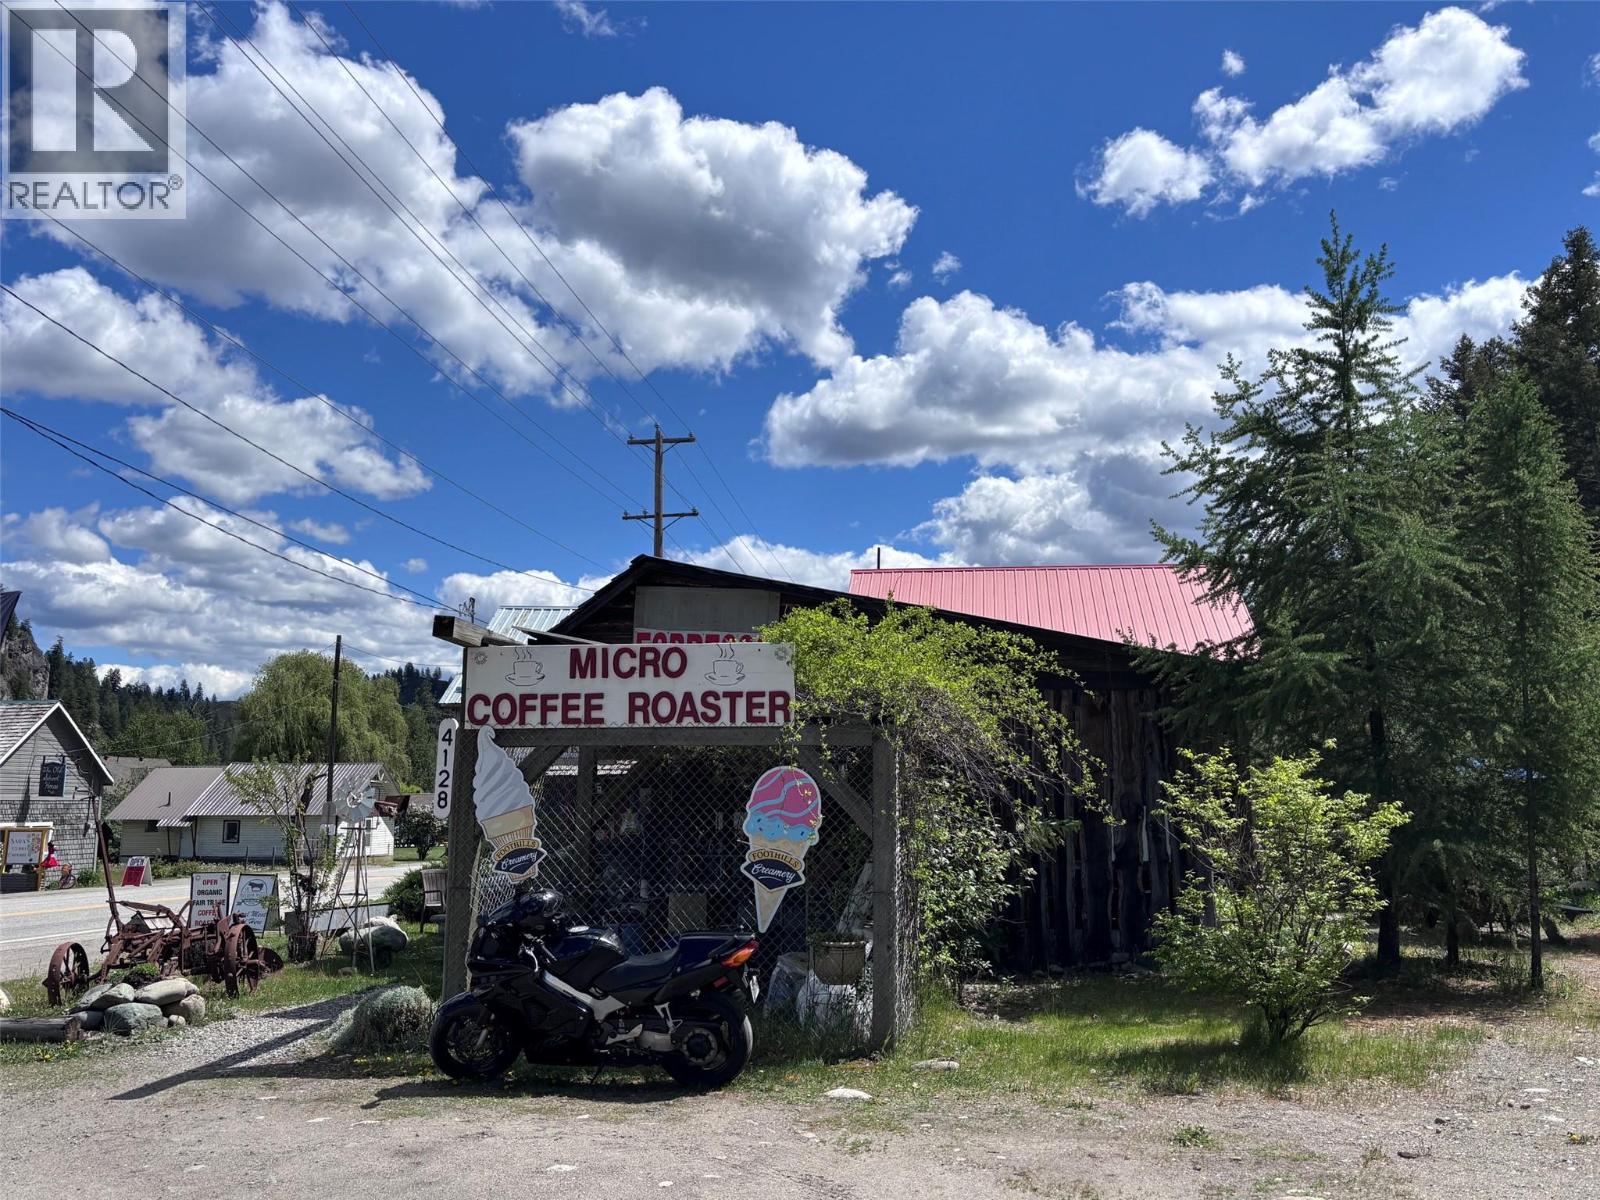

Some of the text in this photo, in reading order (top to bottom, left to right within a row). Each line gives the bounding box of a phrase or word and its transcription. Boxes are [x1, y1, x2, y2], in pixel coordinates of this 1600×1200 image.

[569, 646, 688, 680] MICRO
[467, 690, 791, 726] COFFEE ROASTER
[437, 728, 453, 809] 4128
[495, 839, 537, 860] FOOTHILLS
[501, 851, 538, 870] Creamery
[752, 851, 800, 869] FOOTHILLS
[751, 863, 796, 883] Creamery
[198, 909, 219, 917] COFFE
